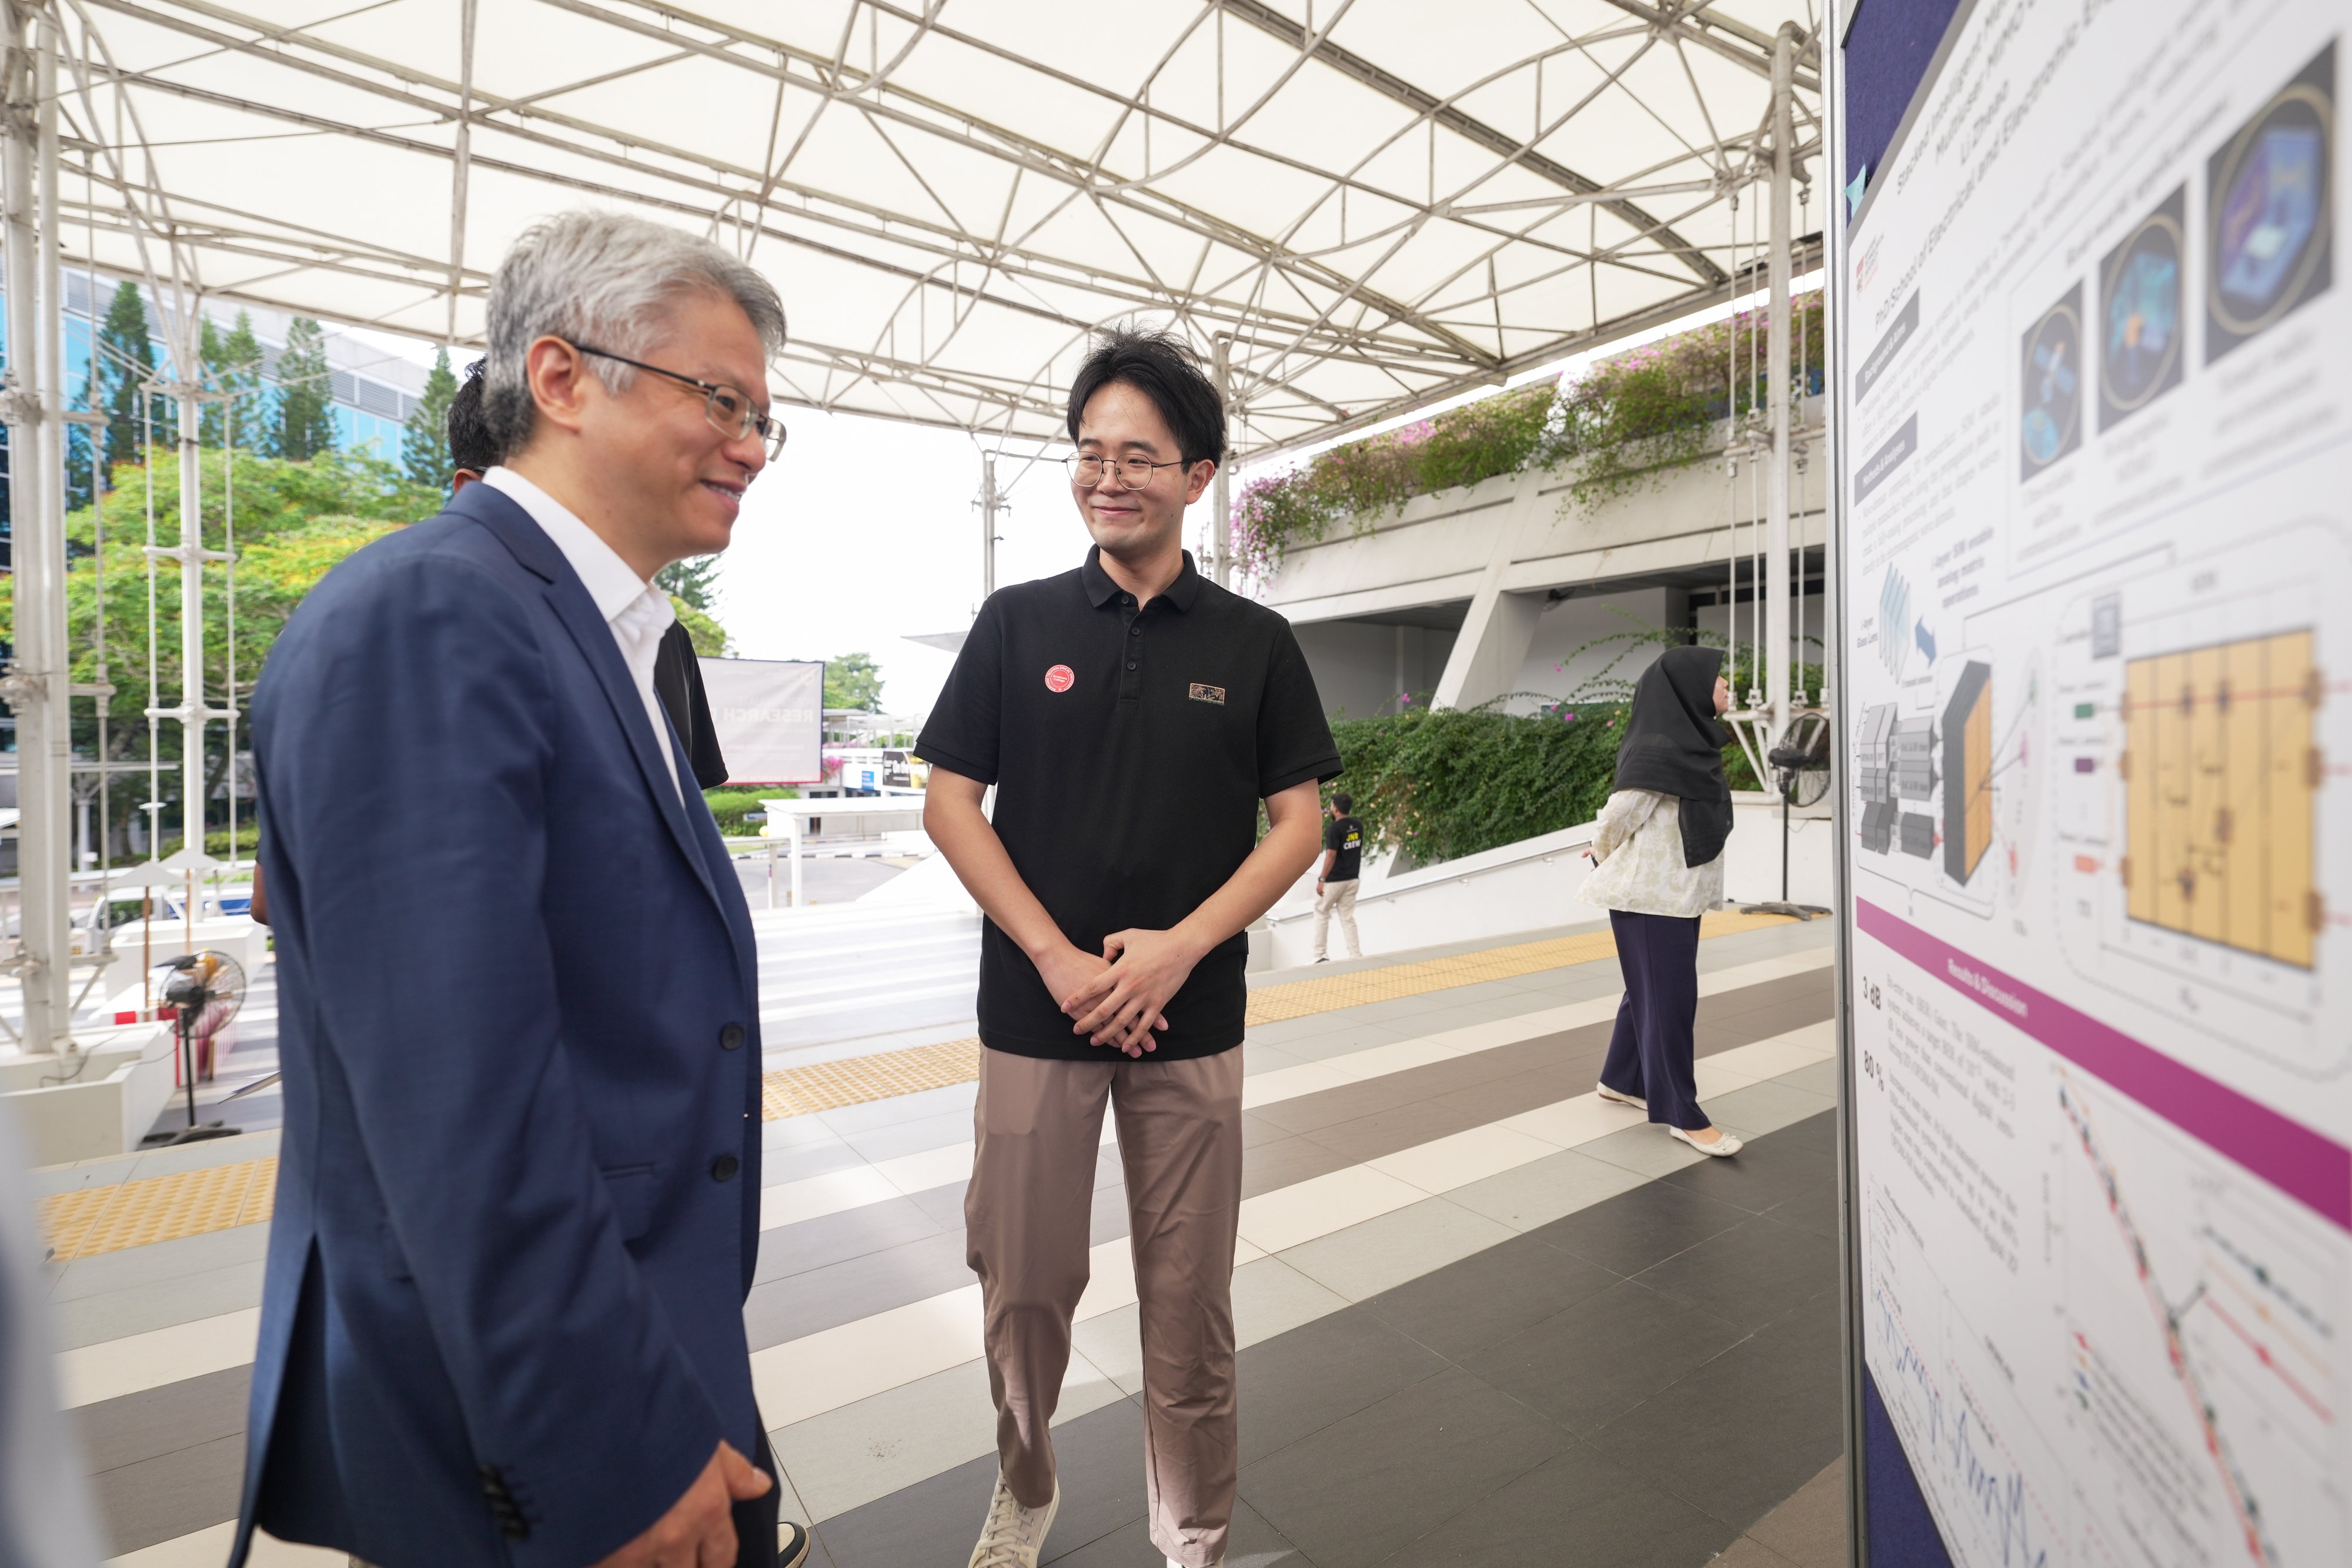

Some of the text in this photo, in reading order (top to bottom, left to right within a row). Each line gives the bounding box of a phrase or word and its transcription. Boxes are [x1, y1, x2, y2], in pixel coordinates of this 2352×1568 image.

[1896, 22, 1982, 202] Stacked Intelligent
[1918, 239, 1926, 271] of
[1929, 166, 1975, 255] Electrical
[1977, 131, 1997, 184] and
[1047, 666, 1071, 677] TECHNOLOGICAL
[1343, 839, 1361, 850] CREW
[1346, 832, 1359, 842] JNR
[1863, 976, 1880, 1010] 3 dB
[1865, 1050, 1884, 1092] 80 %
